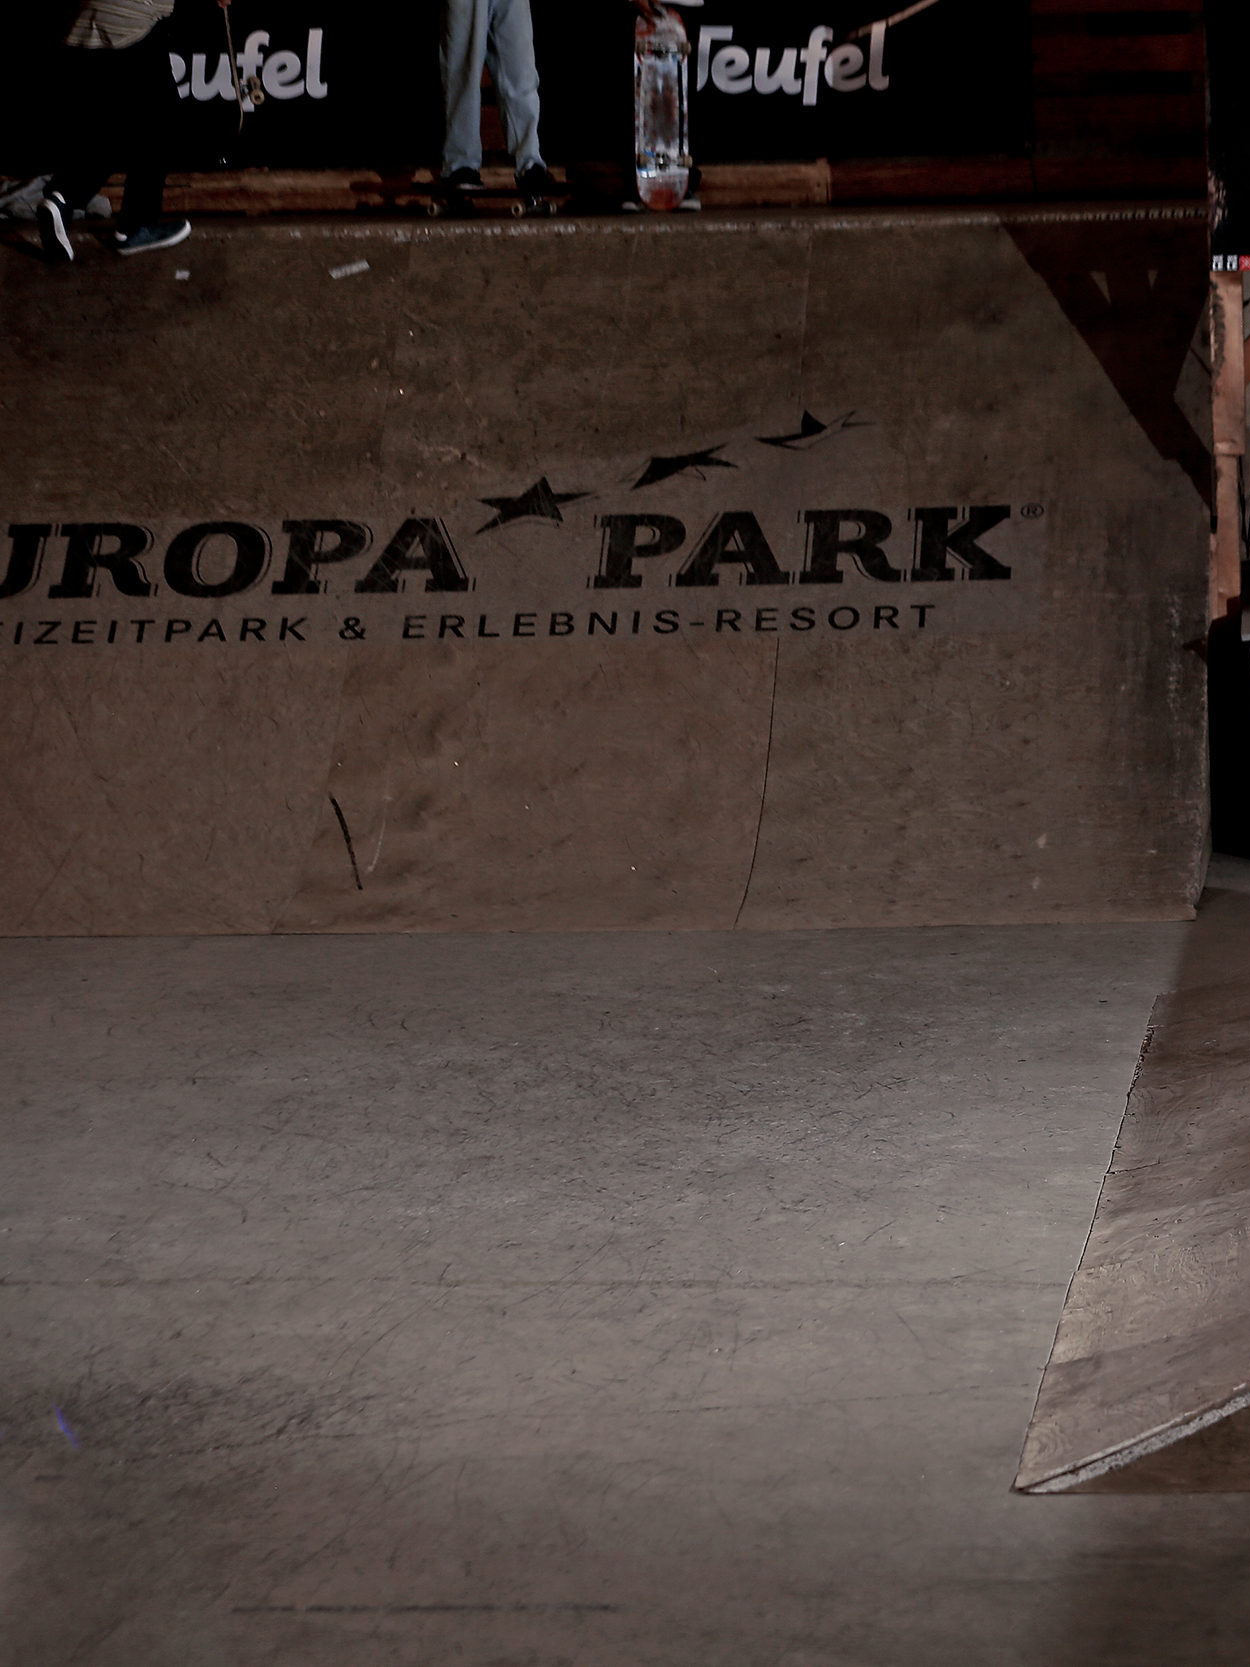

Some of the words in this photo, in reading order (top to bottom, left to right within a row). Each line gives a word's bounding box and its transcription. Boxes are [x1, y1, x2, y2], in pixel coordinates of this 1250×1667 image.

[696, 20, 890, 106] Teufel
[0, 616, 307, 646] IZEITPARK
[338, 616, 366, 641] &
[401, 604, 937, 641] ERLEBNIS-RESORT
